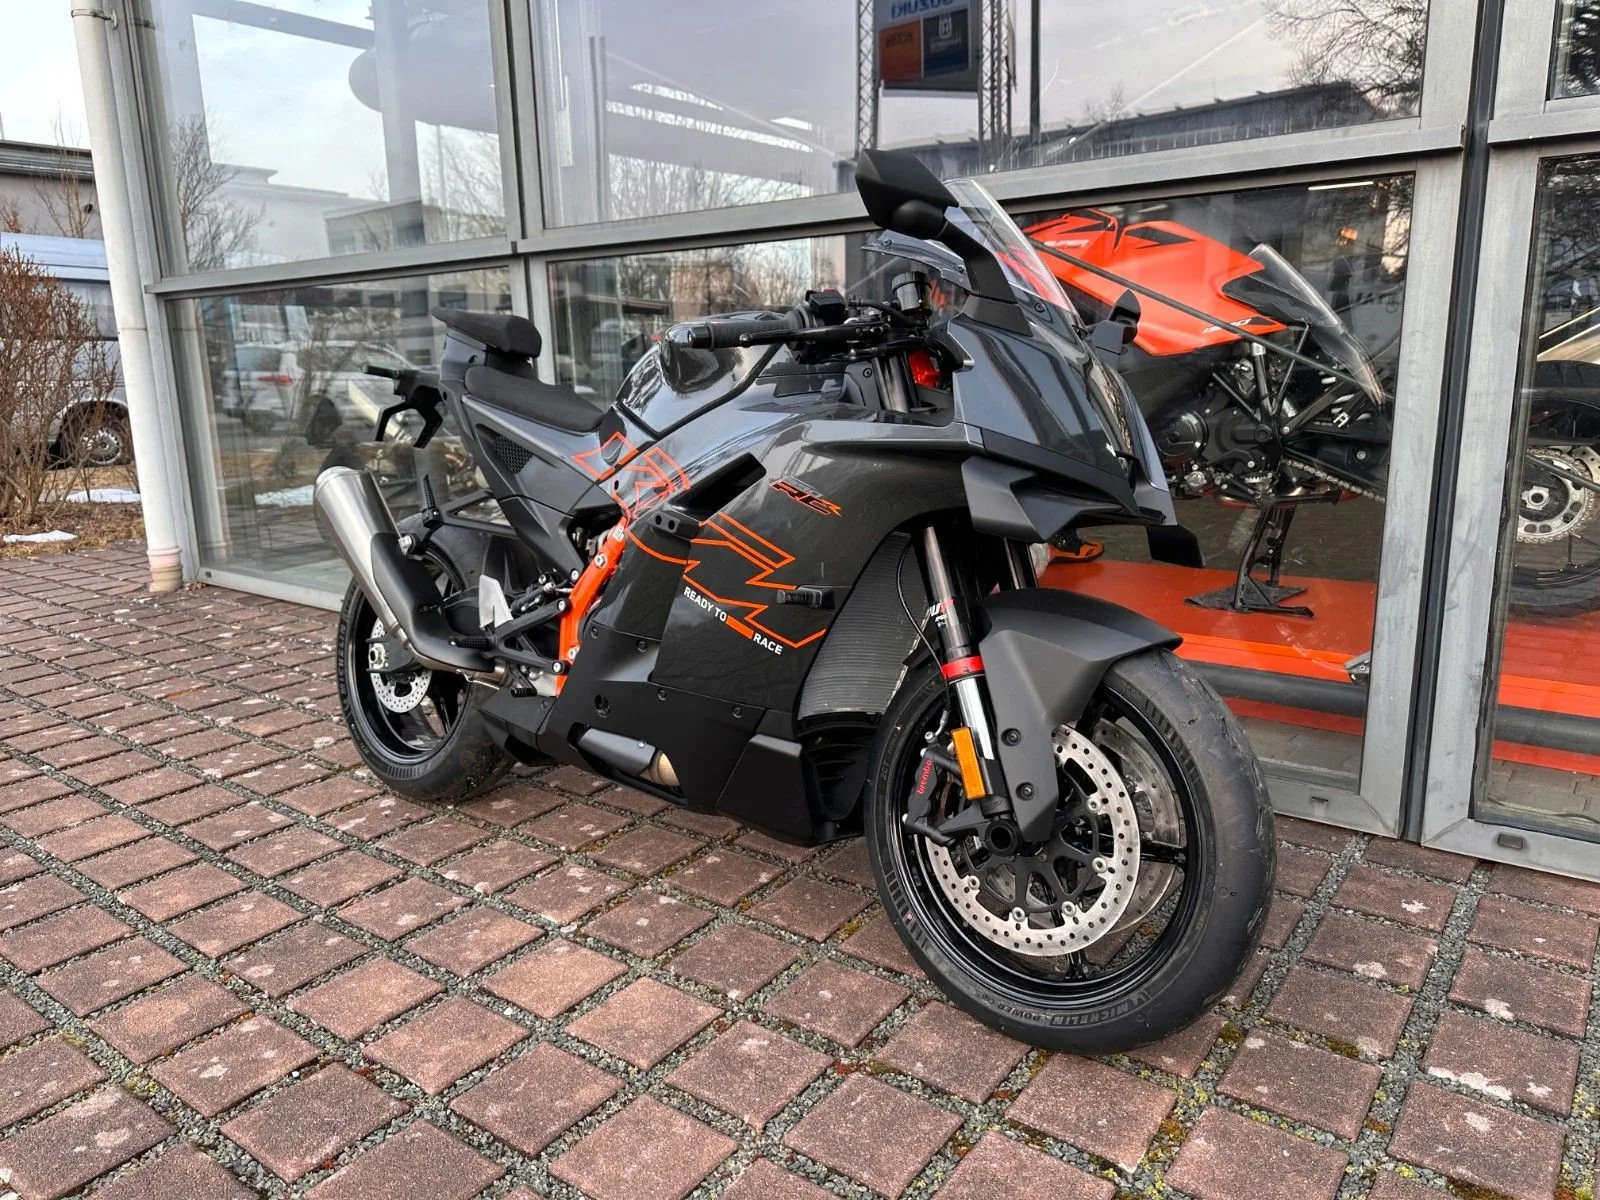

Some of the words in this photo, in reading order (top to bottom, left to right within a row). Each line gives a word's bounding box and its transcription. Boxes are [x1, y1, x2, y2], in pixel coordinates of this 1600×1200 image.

[683, 586, 714, 612] READY
[714, 607, 727, 622] TO
[752, 633, 783, 655] RACE
[338, 624, 347, 695] MICHELIN
[917, 760, 932, 794] brembo
[997, 1003, 1042, 1022] POWER
[1052, 1005, 1129, 1026] MICHELIN
